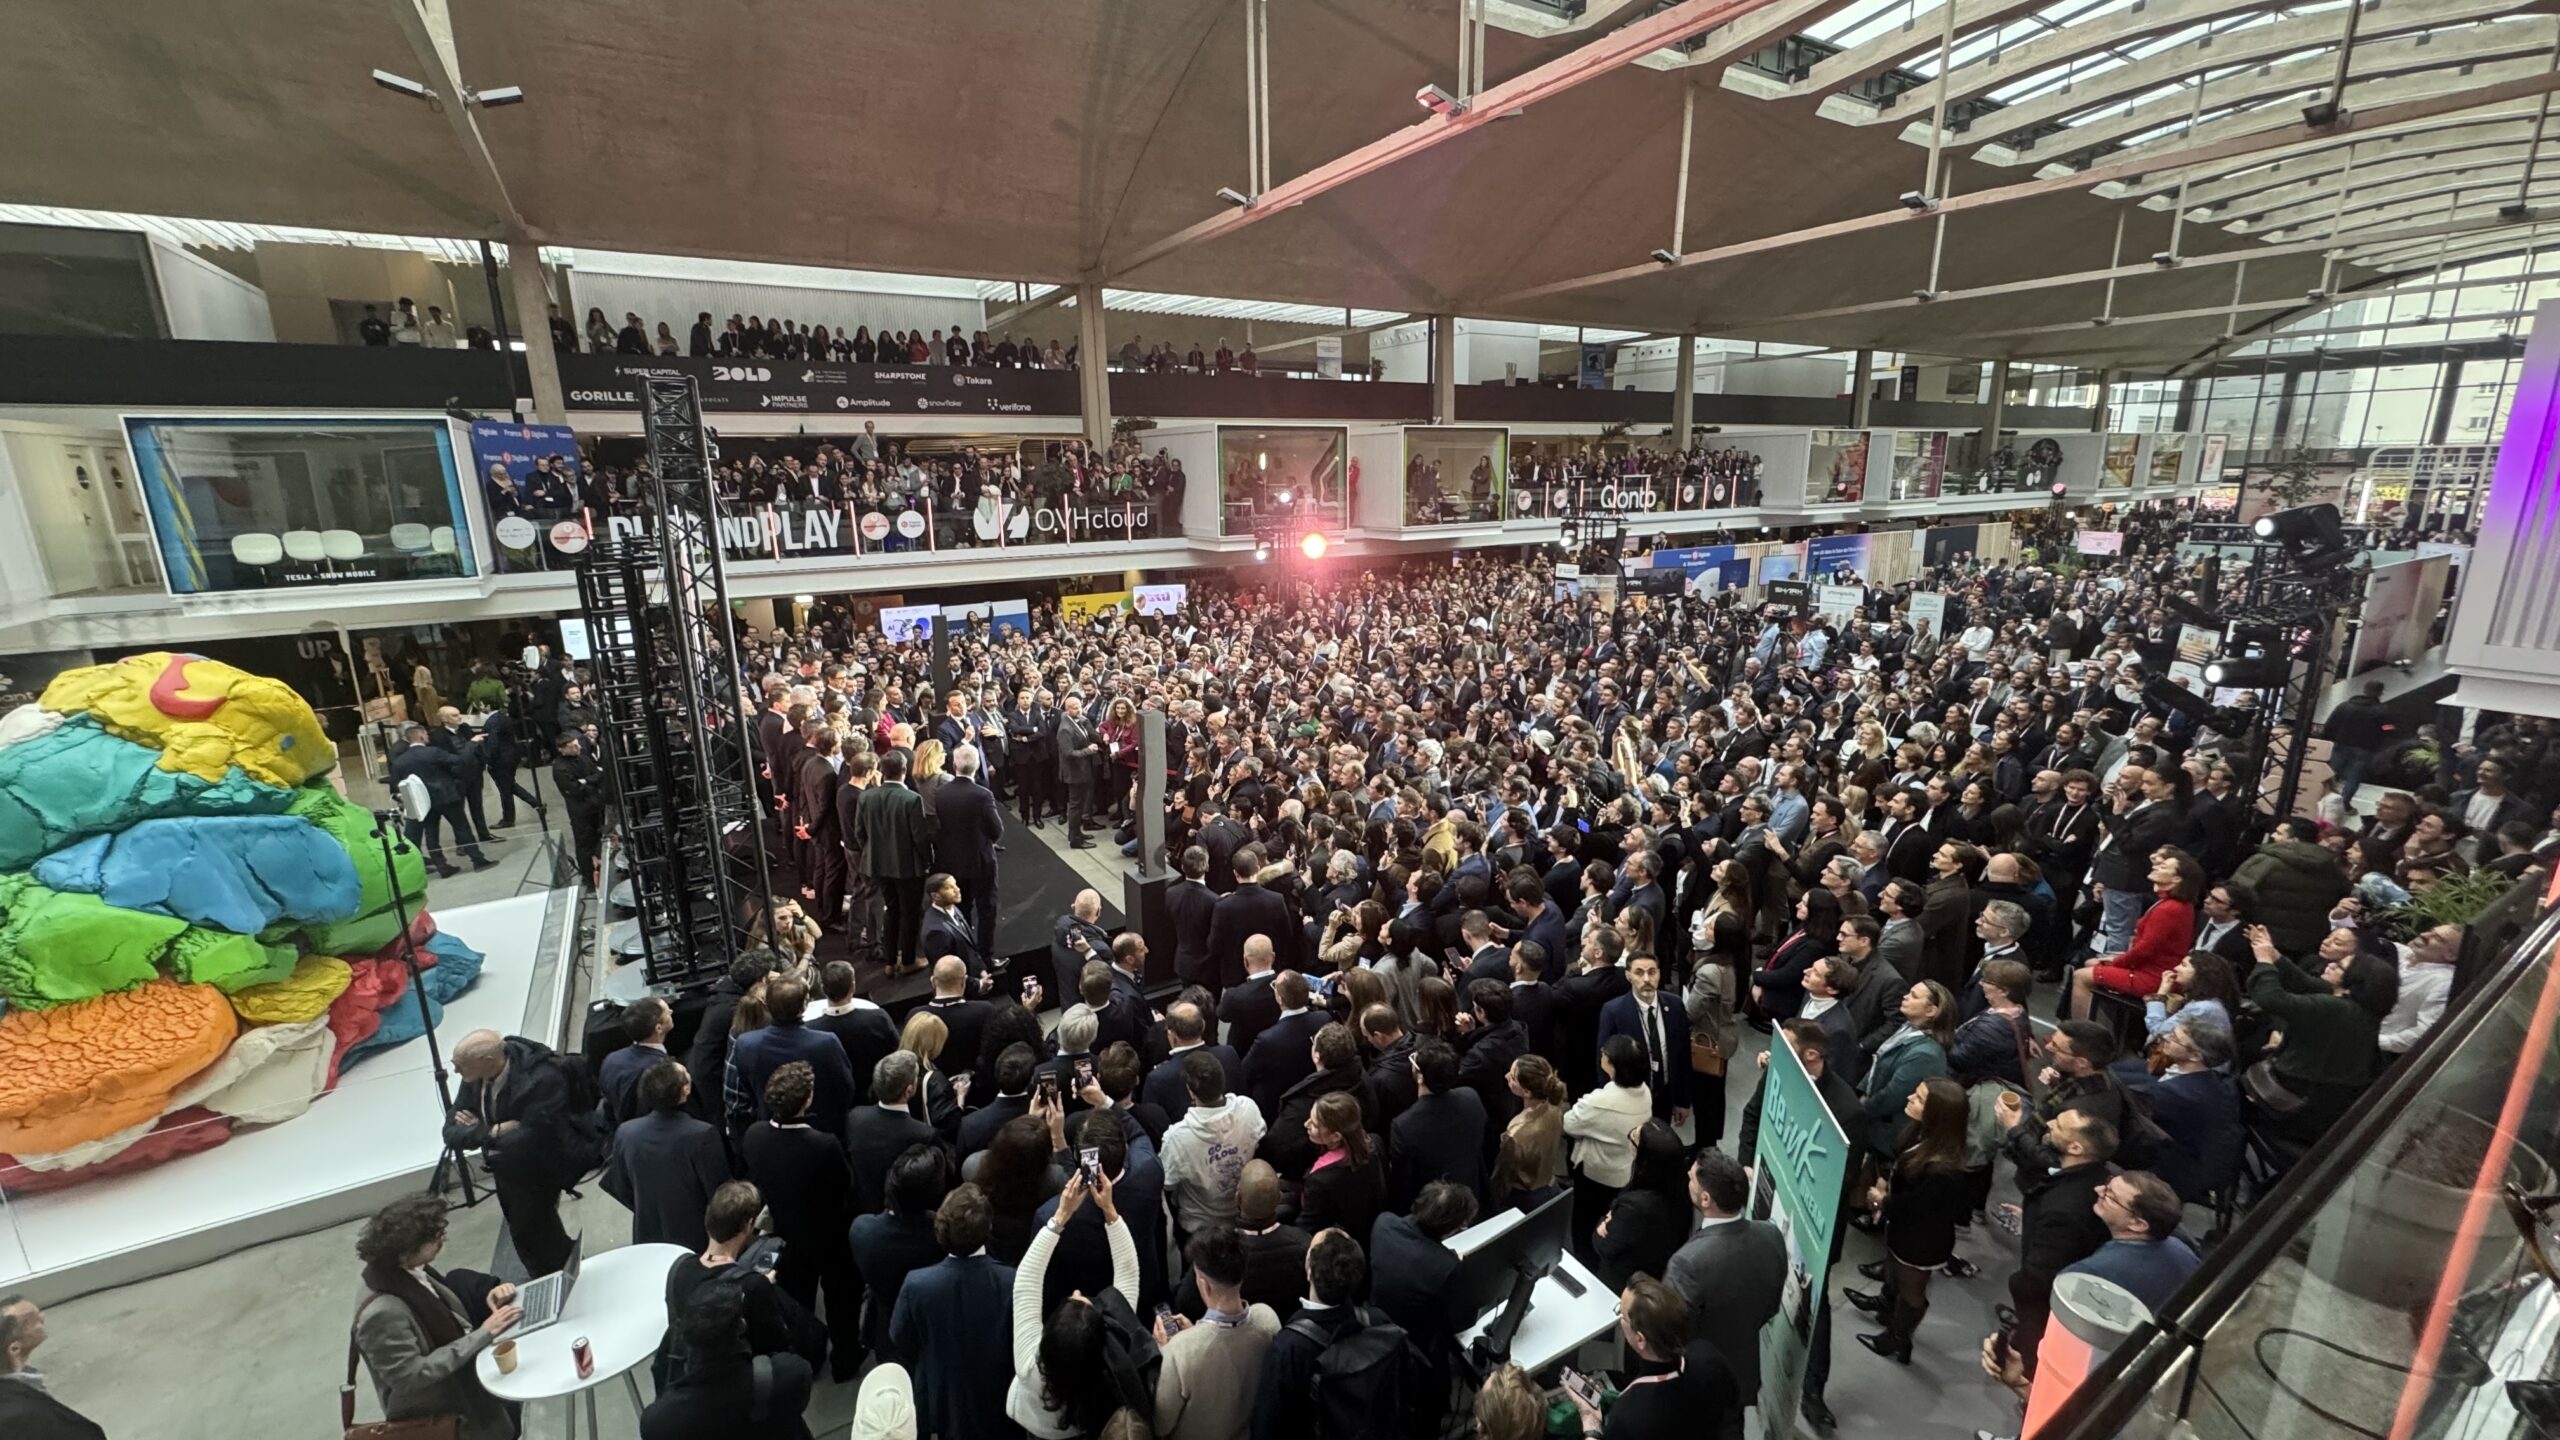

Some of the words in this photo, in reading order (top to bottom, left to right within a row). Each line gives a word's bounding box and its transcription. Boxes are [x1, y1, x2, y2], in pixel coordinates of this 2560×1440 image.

[624, 368, 650, 377] SUPER
[651, 369, 682, 377] CAPITAL
[712, 366, 772, 382] BOLD
[874, 371, 927, 381] SHARPSTONE
[966, 376, 993, 385] Takara
[850, 398, 891, 407] Amplitude
[1600, 484, 1657, 509] Qonto
[1035, 506, 1149, 532] OVHcloud
[285, 573, 312, 582] TESLA
[320, 571, 344, 579] SNOW
[345, 570, 376, 578] MOBILE
[1208, 1144, 1222, 1156] GO
[1209, 1146, 1238, 1165] FLOW
